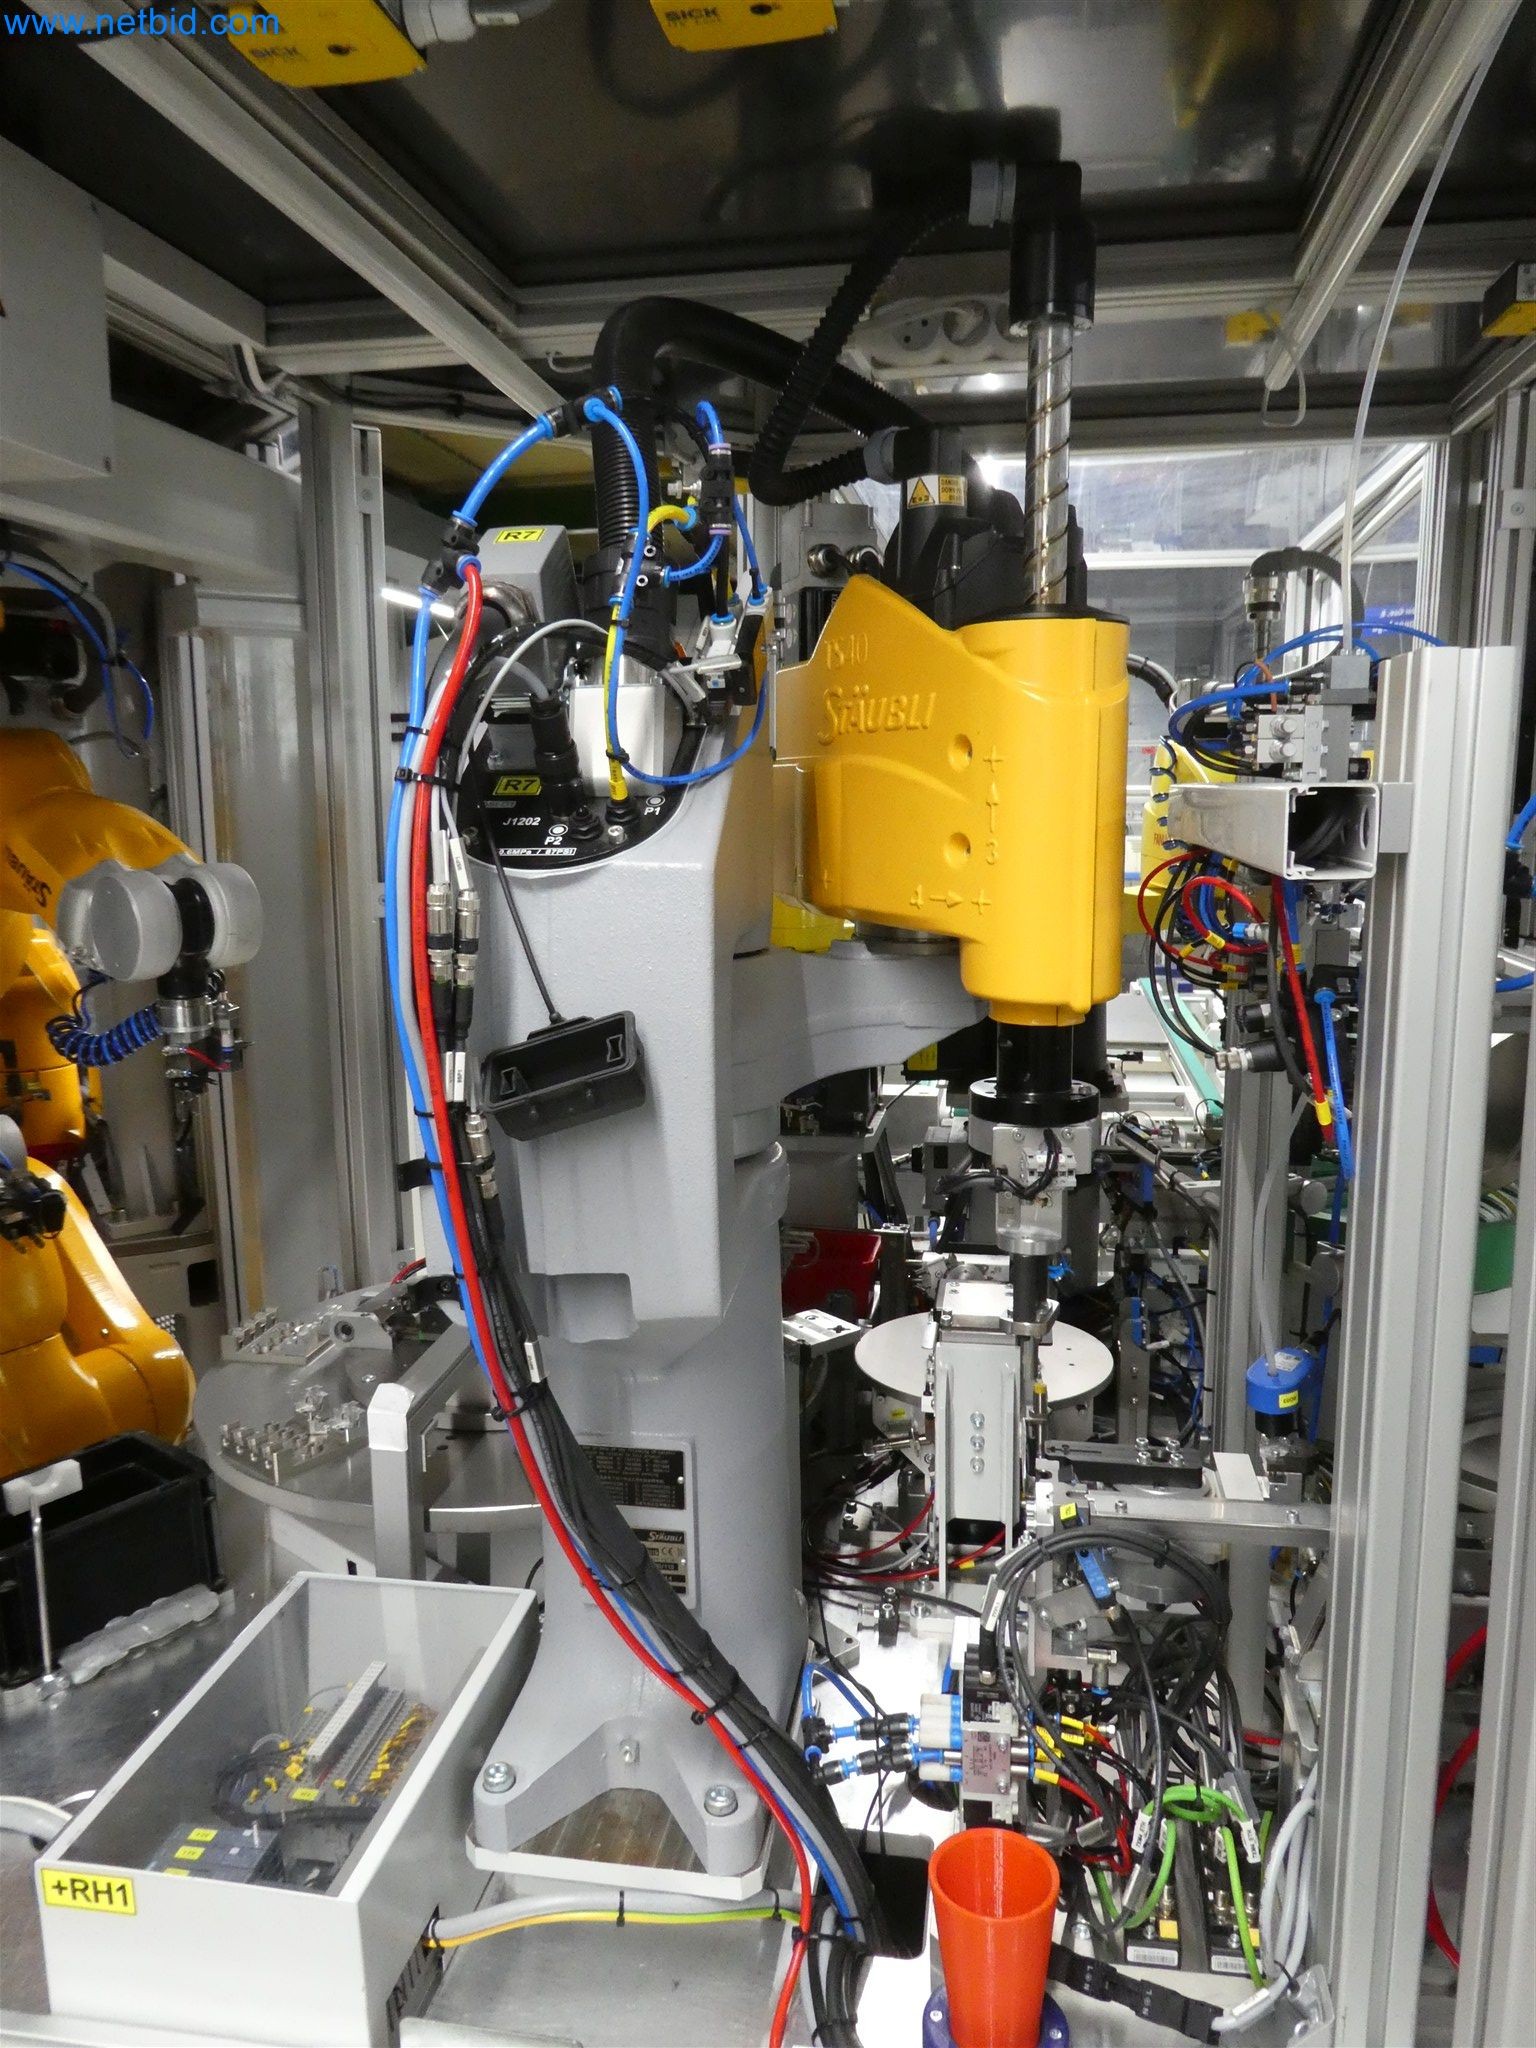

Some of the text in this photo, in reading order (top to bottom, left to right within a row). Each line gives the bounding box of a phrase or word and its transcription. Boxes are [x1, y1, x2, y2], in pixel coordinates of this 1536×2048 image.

[503, 530, 538, 541] R7
[503, 778, 537, 792] R7
[644, 806, 661, 816] P1
[502, 816, 542, 826] J1202
[544, 836, 563, 846] P2
[52, 1877, 128, 1907] +RH1
